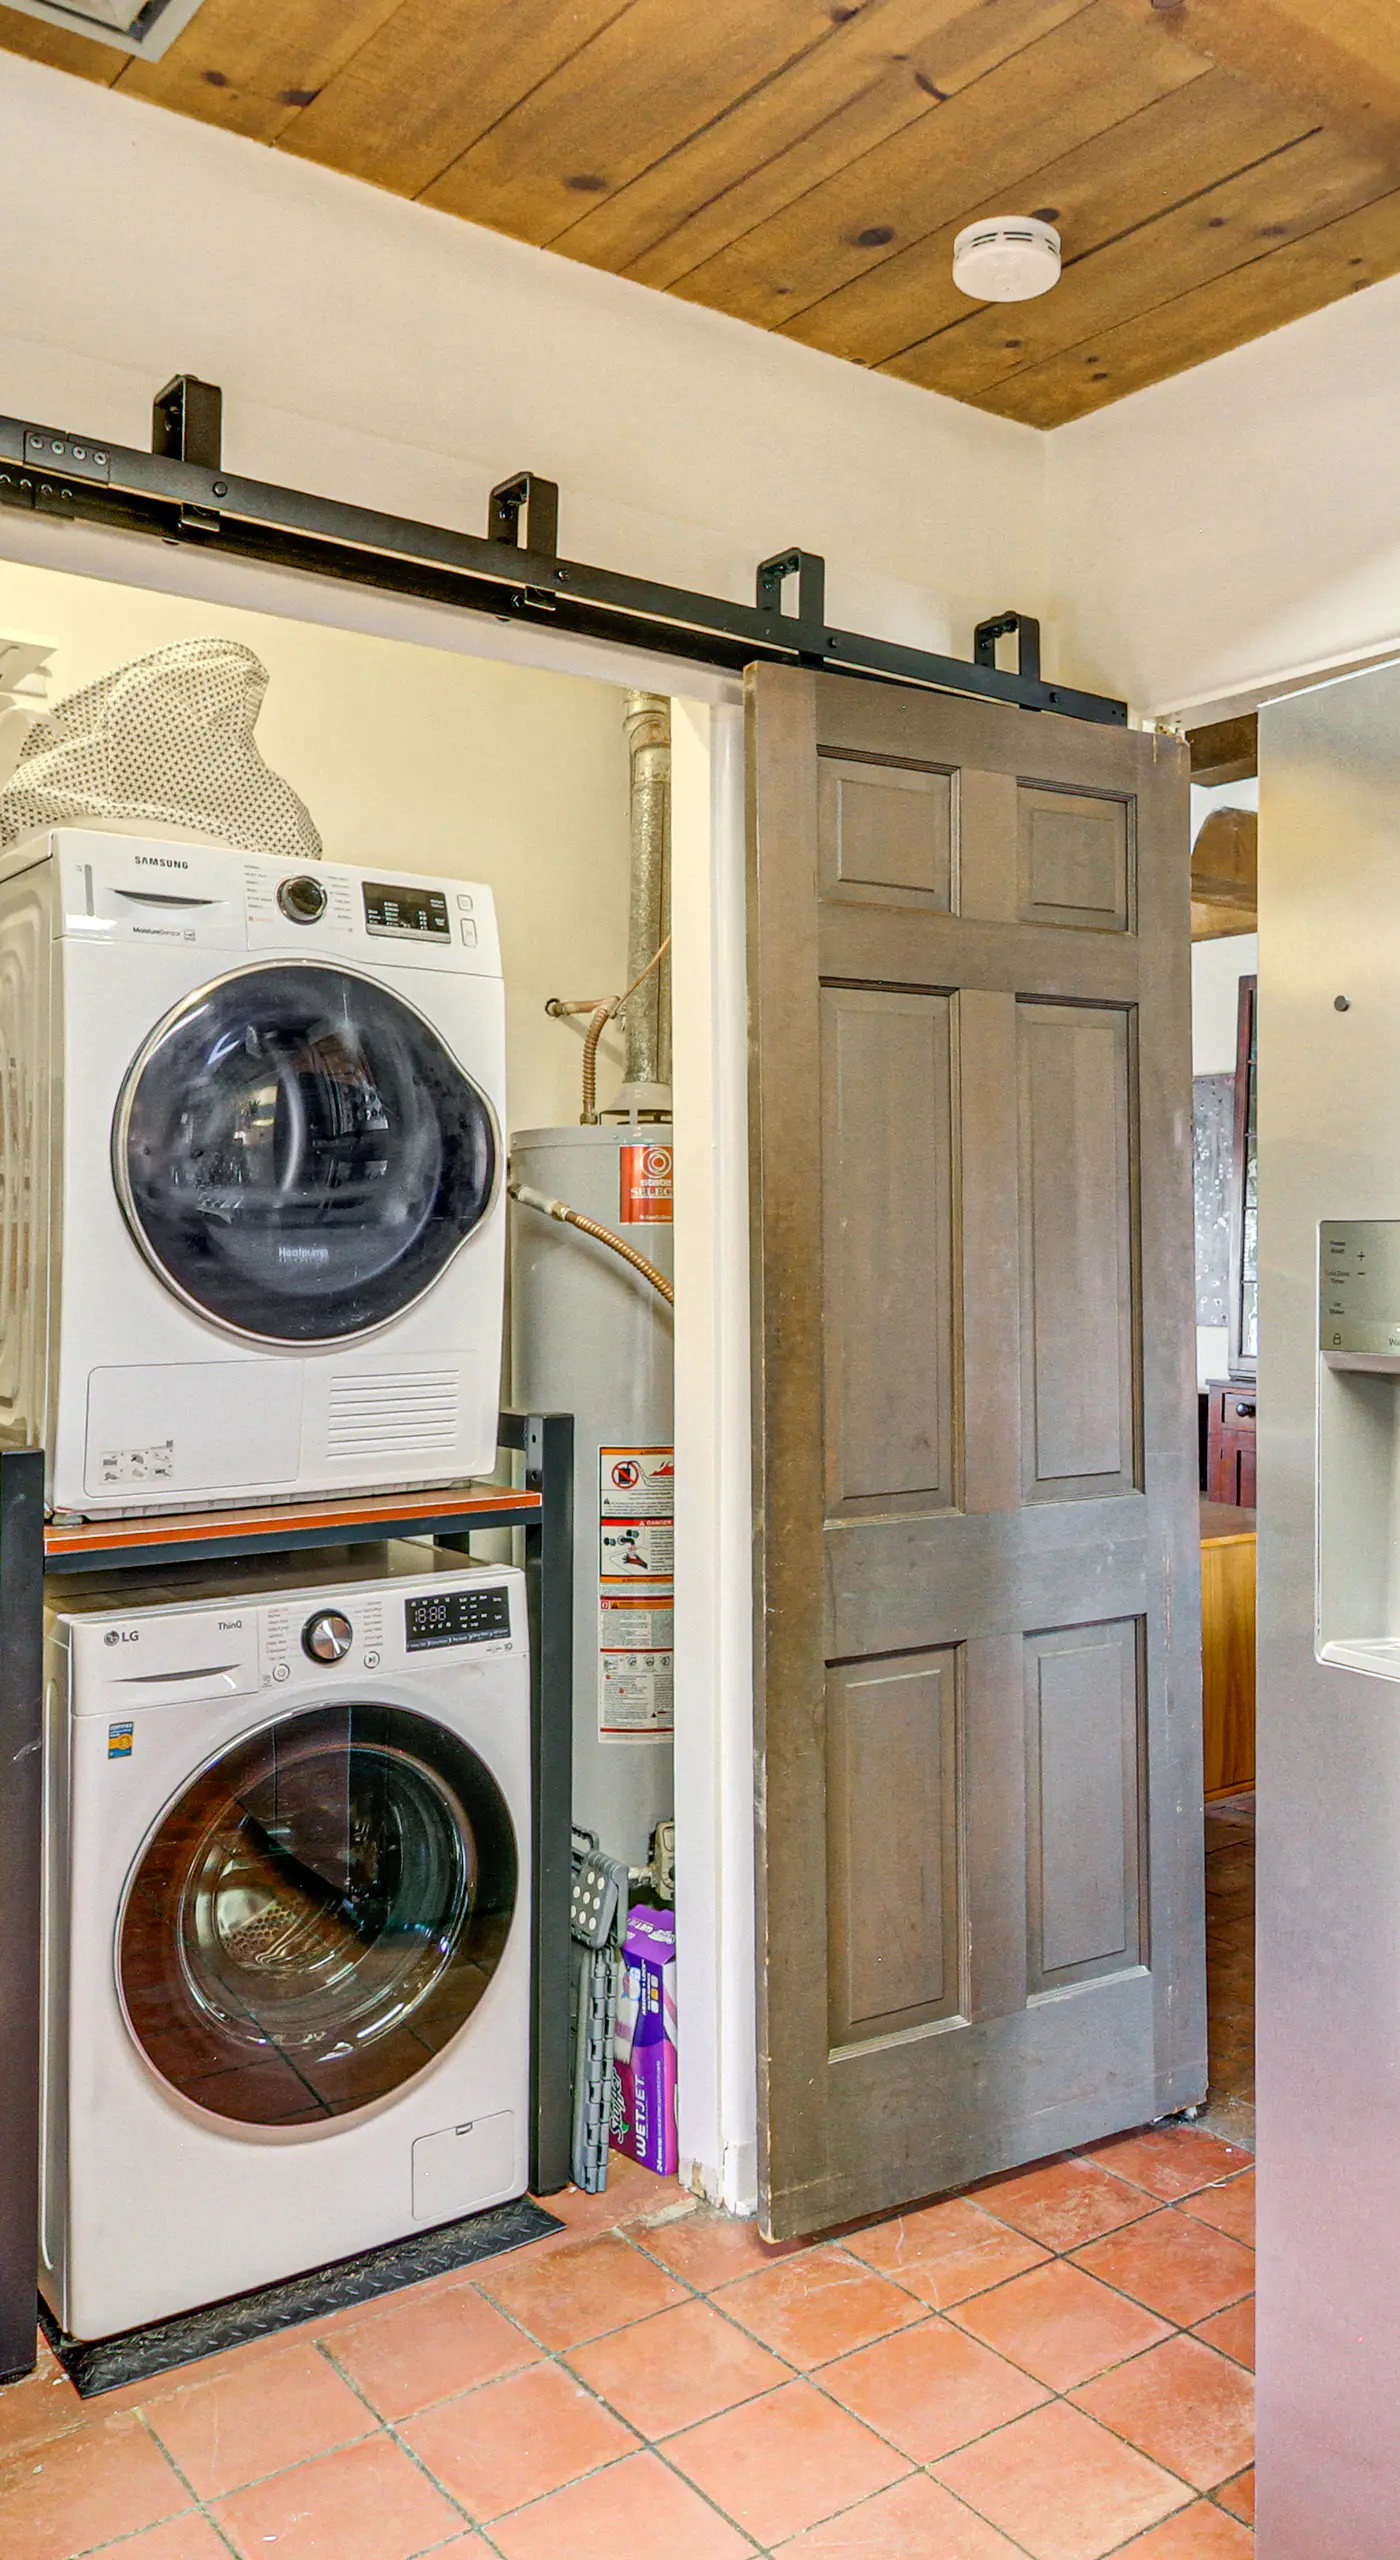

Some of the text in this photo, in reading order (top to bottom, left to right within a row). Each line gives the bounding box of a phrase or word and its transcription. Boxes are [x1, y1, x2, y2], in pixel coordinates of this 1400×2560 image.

[134, 856, 189, 870] SAMSUNG
[217, 1620, 242, 1631] ThinQ
[121, 1631, 139, 1642] LG
[609, 2066, 626, 2144] Swiffer
[635, 2074, 647, 2158] WETJET
